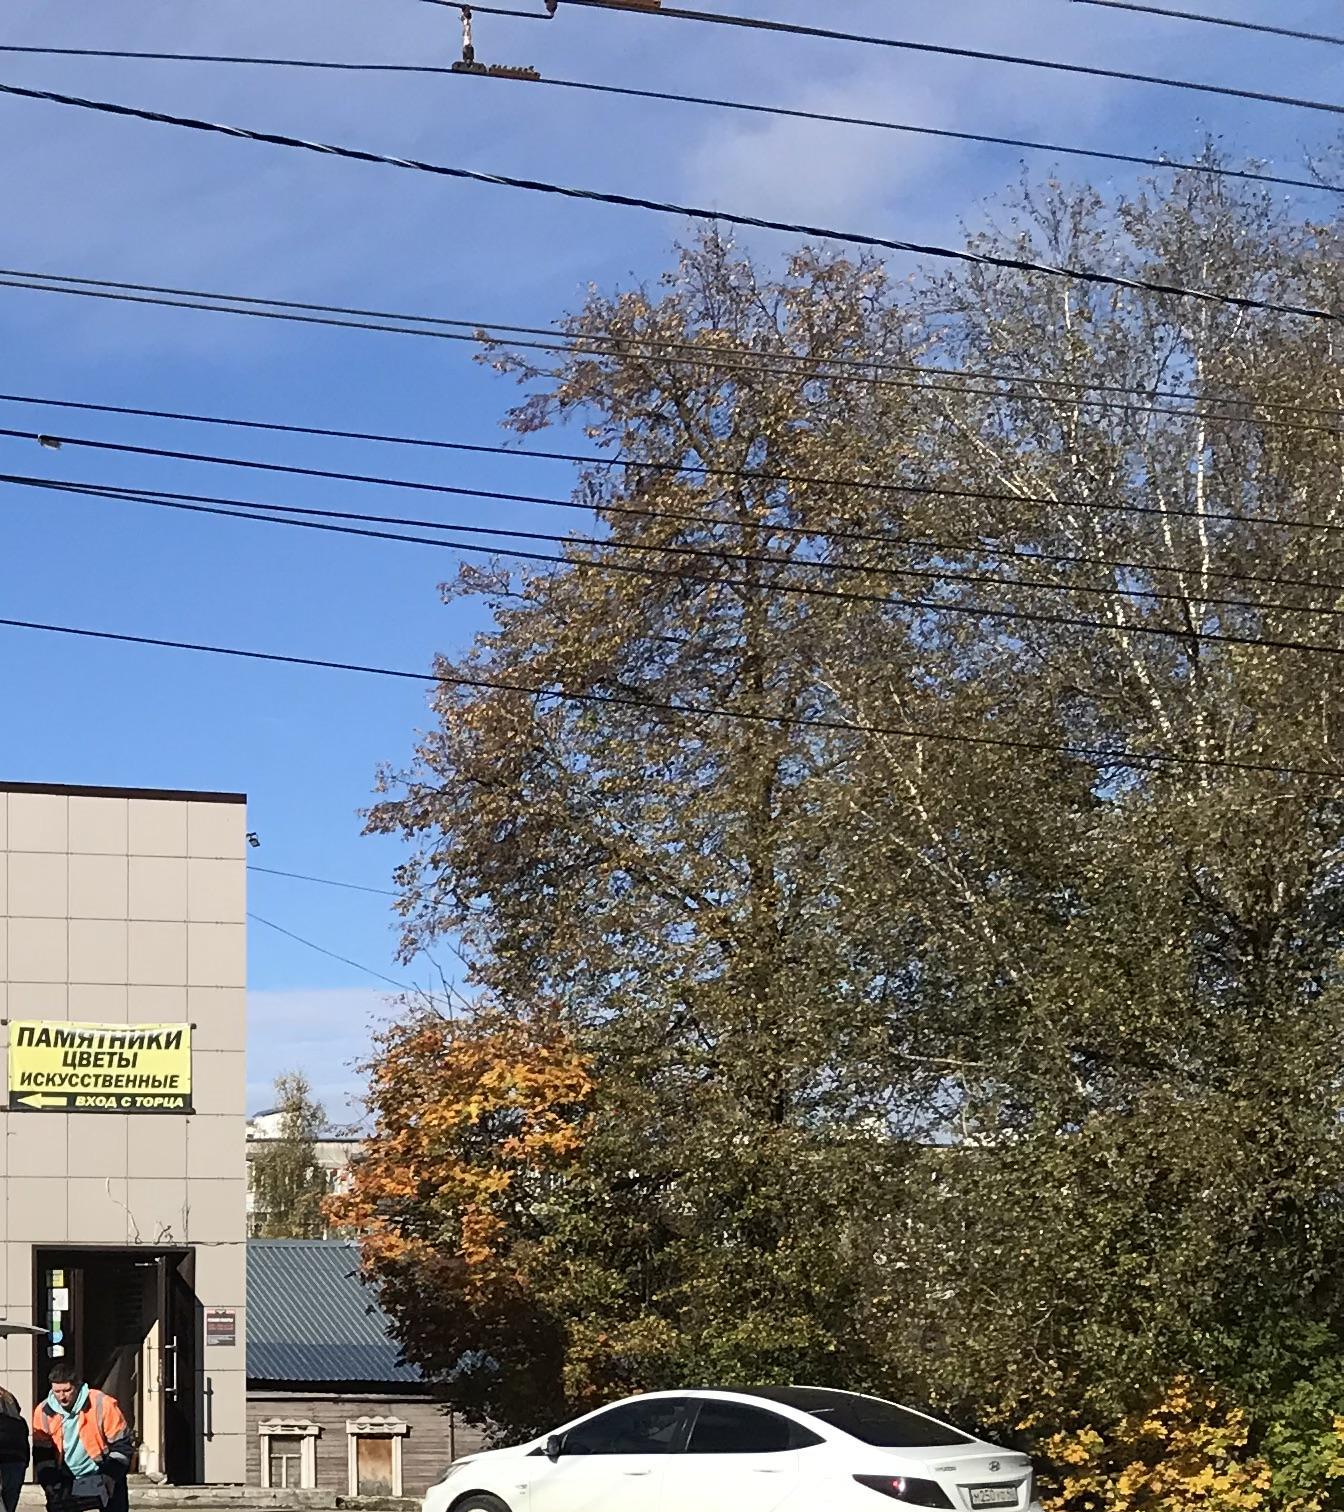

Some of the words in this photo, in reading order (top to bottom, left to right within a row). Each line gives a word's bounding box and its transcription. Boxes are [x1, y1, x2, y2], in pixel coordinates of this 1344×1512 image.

[16, 1026, 183, 1050] ПАМЯТНИКИ
[61, 1050, 138, 1070] ЦВЕТЫ
[19, 1072, 180, 1089] ИСКУССТВЕННЫЕ
[74, 1096, 118, 1109] ВХОД
[120, 1096, 132, 1107] С
[135, 1097, 184, 1109] ТОРЦА
